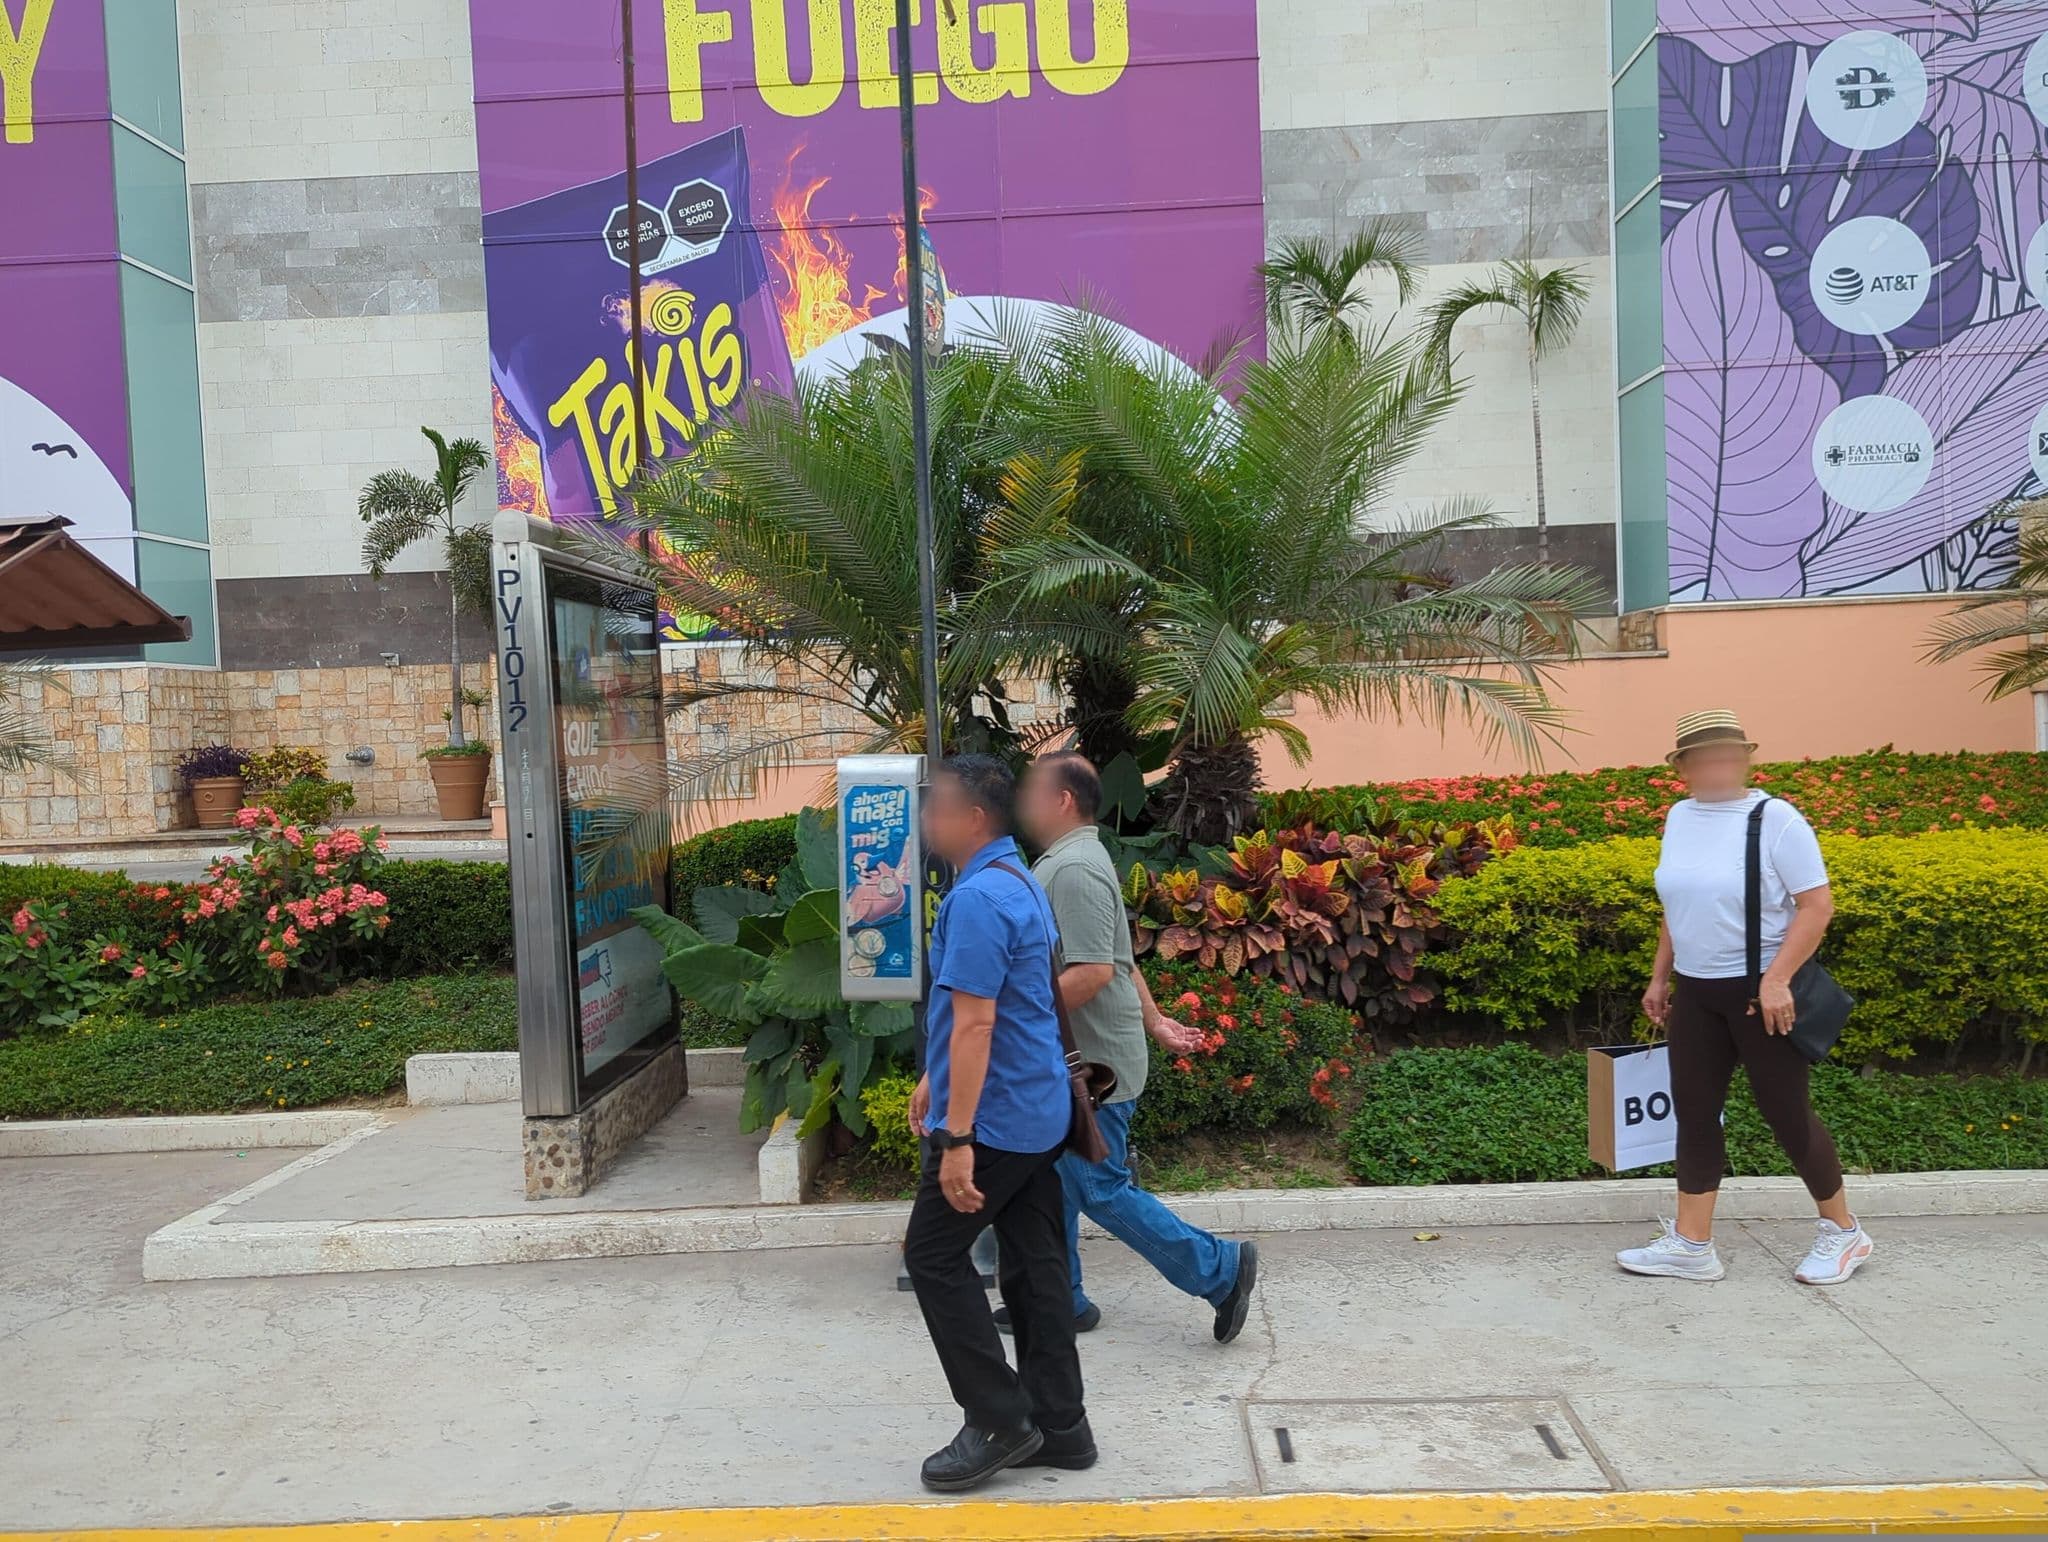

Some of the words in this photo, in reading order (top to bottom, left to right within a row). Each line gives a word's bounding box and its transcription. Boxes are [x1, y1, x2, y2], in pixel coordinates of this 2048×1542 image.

[663, 0, 1130, 123] FUEGO
[678, 198, 715, 218] EXCESO
[686, 210, 714, 227] SODIO
[616, 220, 653, 239] EXSO
[1869, 273, 1919, 293] AT&T
[547, 290, 742, 519] Takis
[1847, 442, 1922, 456] FARMACIA
[496, 569, 528, 733] PV1012
[853, 790, 897, 806] ahorra
[881, 817, 904, 828] con
[1624, 1091, 1672, 1127] BO
